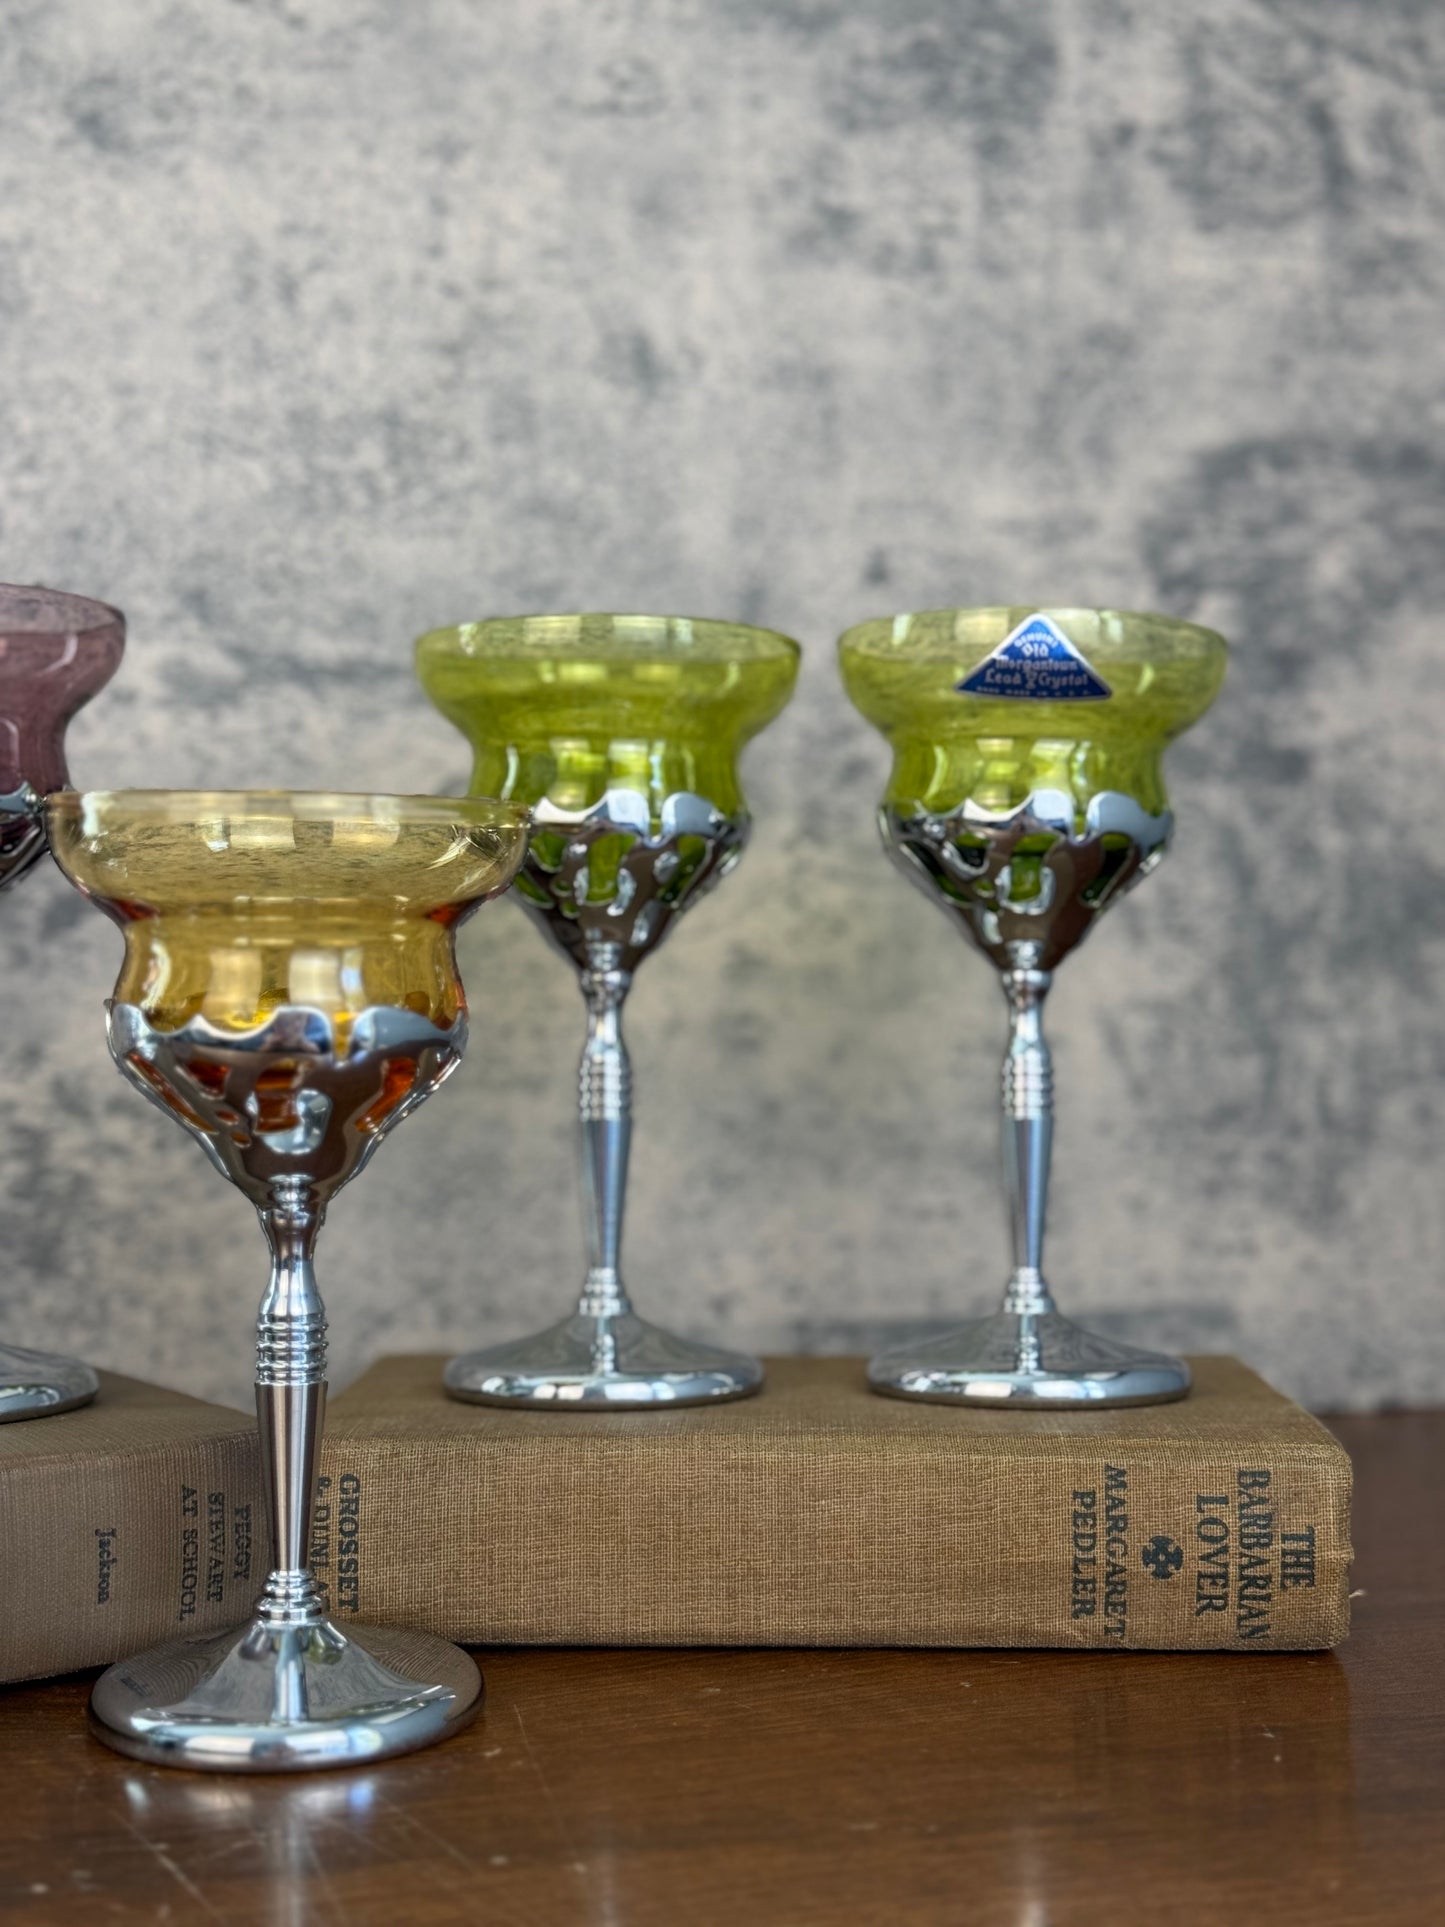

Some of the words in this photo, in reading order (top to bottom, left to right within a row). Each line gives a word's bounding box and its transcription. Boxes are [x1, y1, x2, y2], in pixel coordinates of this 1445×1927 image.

[985, 669, 1022, 684] Lead
[1038, 672, 1088, 689] Crystal
[1021, 643, 1049, 658] Old
[181, 1484, 198, 1517] AT
[315, 1476, 333, 1498] &
[95, 1527, 118, 1604] Jackson
[179, 1528, 199, 1621] SCHOOL
[207, 1491, 225, 1602] STEWART
[234, 1504, 251, 1581] PEGGY
[309, 1504, 332, 1612] DUNLA
[337, 1473, 361, 1613] GROSSET
[1071, 1490, 1097, 1620] PEDLER
[1103, 1464, 1129, 1640] MARGARET
[1195, 1494, 1230, 1616] LOVER
[1237, 1469, 1273, 1640] BARBARIAN
[1280, 1526, 1316, 1590] THE
